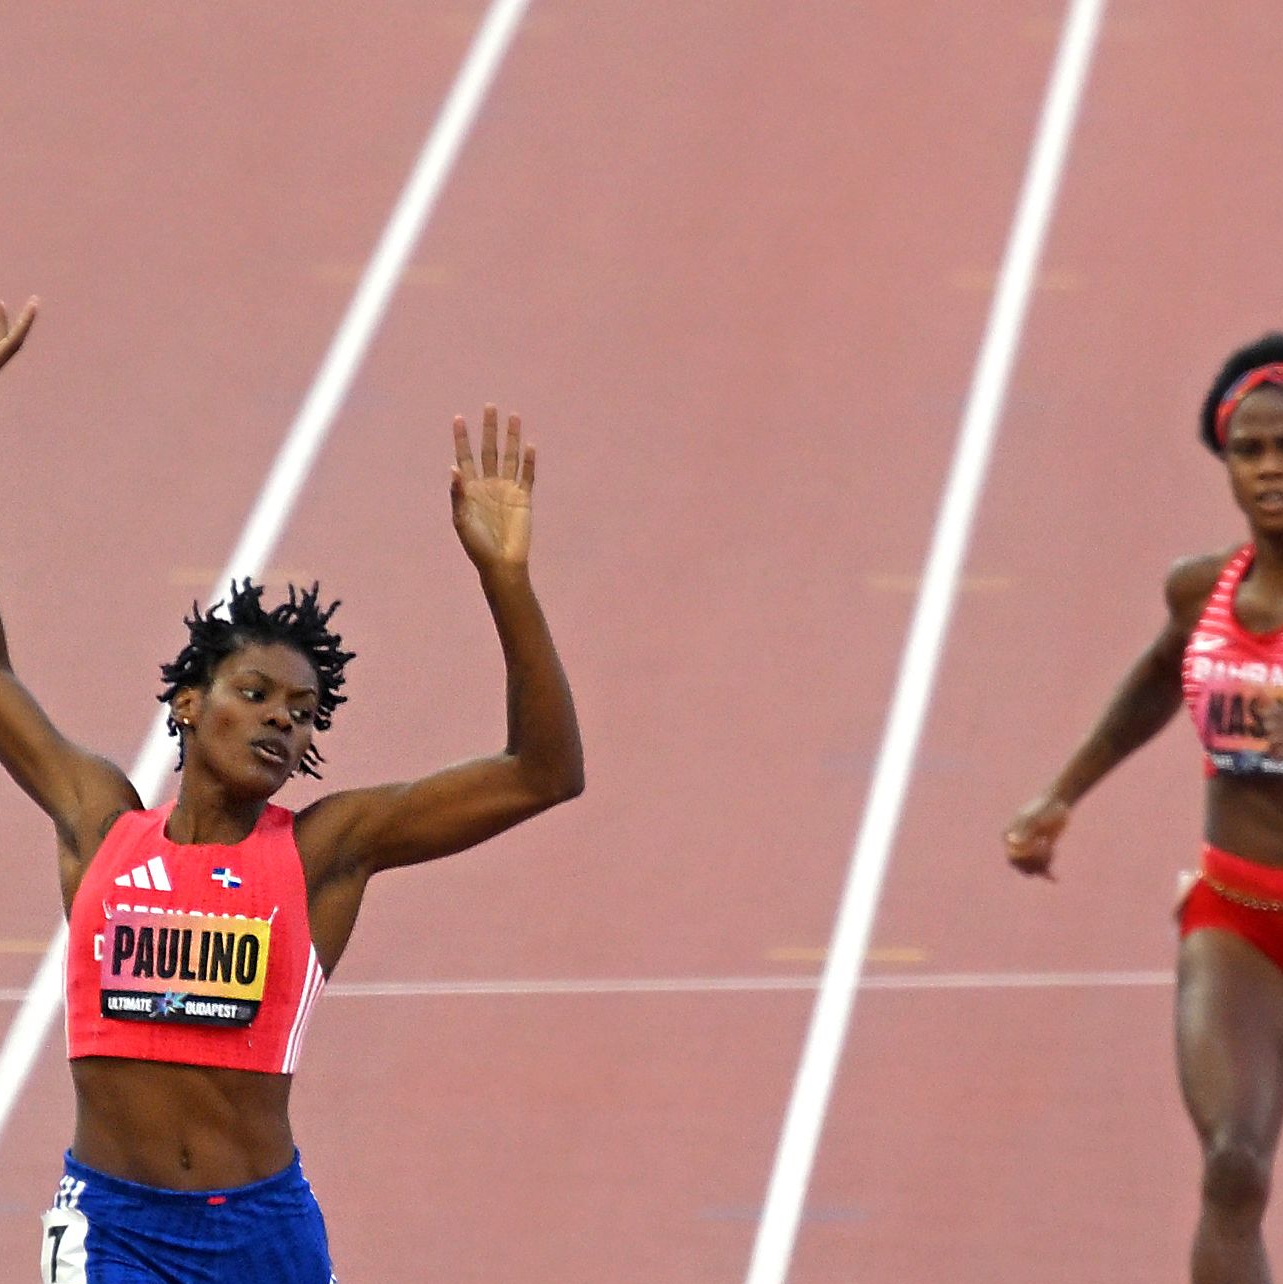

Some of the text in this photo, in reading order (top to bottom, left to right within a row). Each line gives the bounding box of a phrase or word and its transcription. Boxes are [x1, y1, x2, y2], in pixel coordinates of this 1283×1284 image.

[111, 925, 260, 985] PAULINO
[107, 996, 152, 1013] ULTIMATE
[47, 1225, 69, 1284] 7
